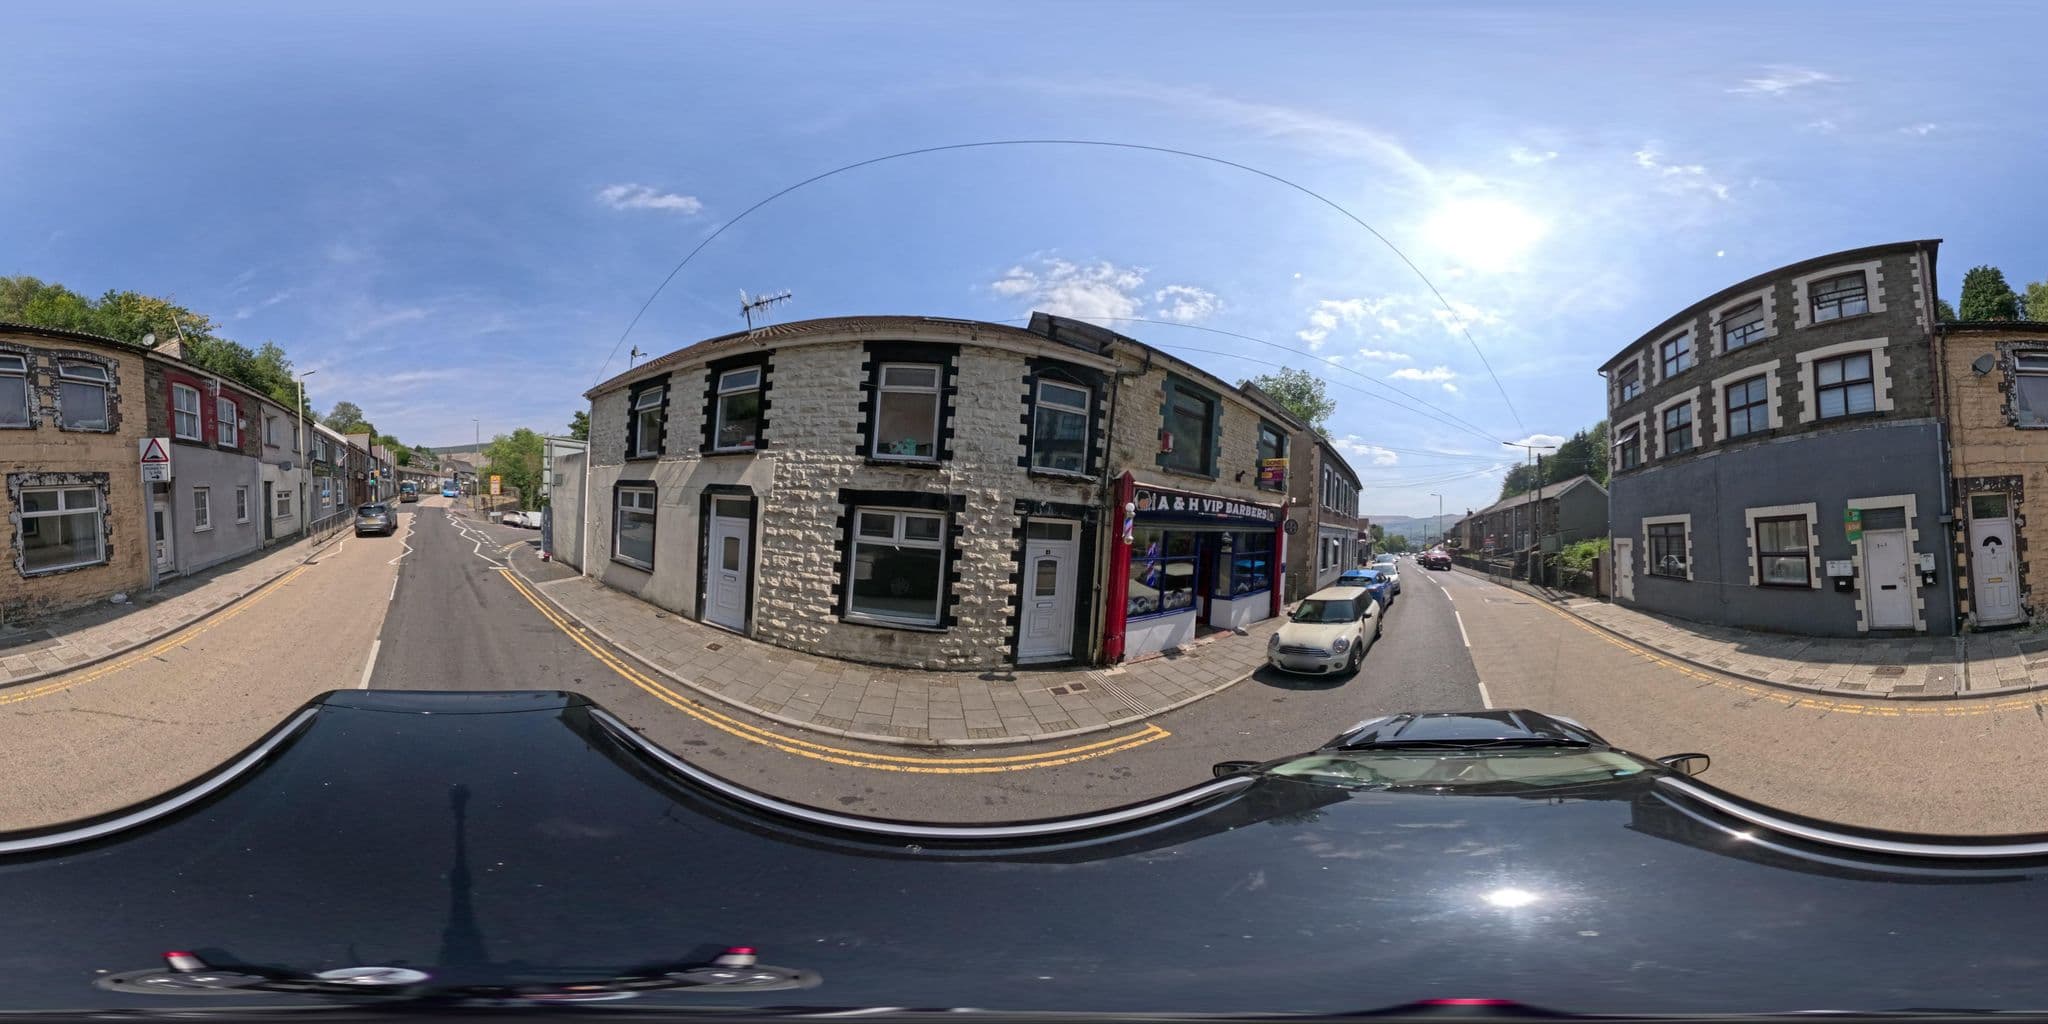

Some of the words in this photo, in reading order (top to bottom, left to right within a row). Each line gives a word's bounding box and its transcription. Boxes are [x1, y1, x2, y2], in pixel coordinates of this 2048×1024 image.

[1157, 496, 1169, 510] A
[1173, 496, 1185, 511] &
[1188, 497, 1199, 511] H
[1202, 499, 1223, 512] VIP
[1225, 501, 1267, 520] BARBERS
